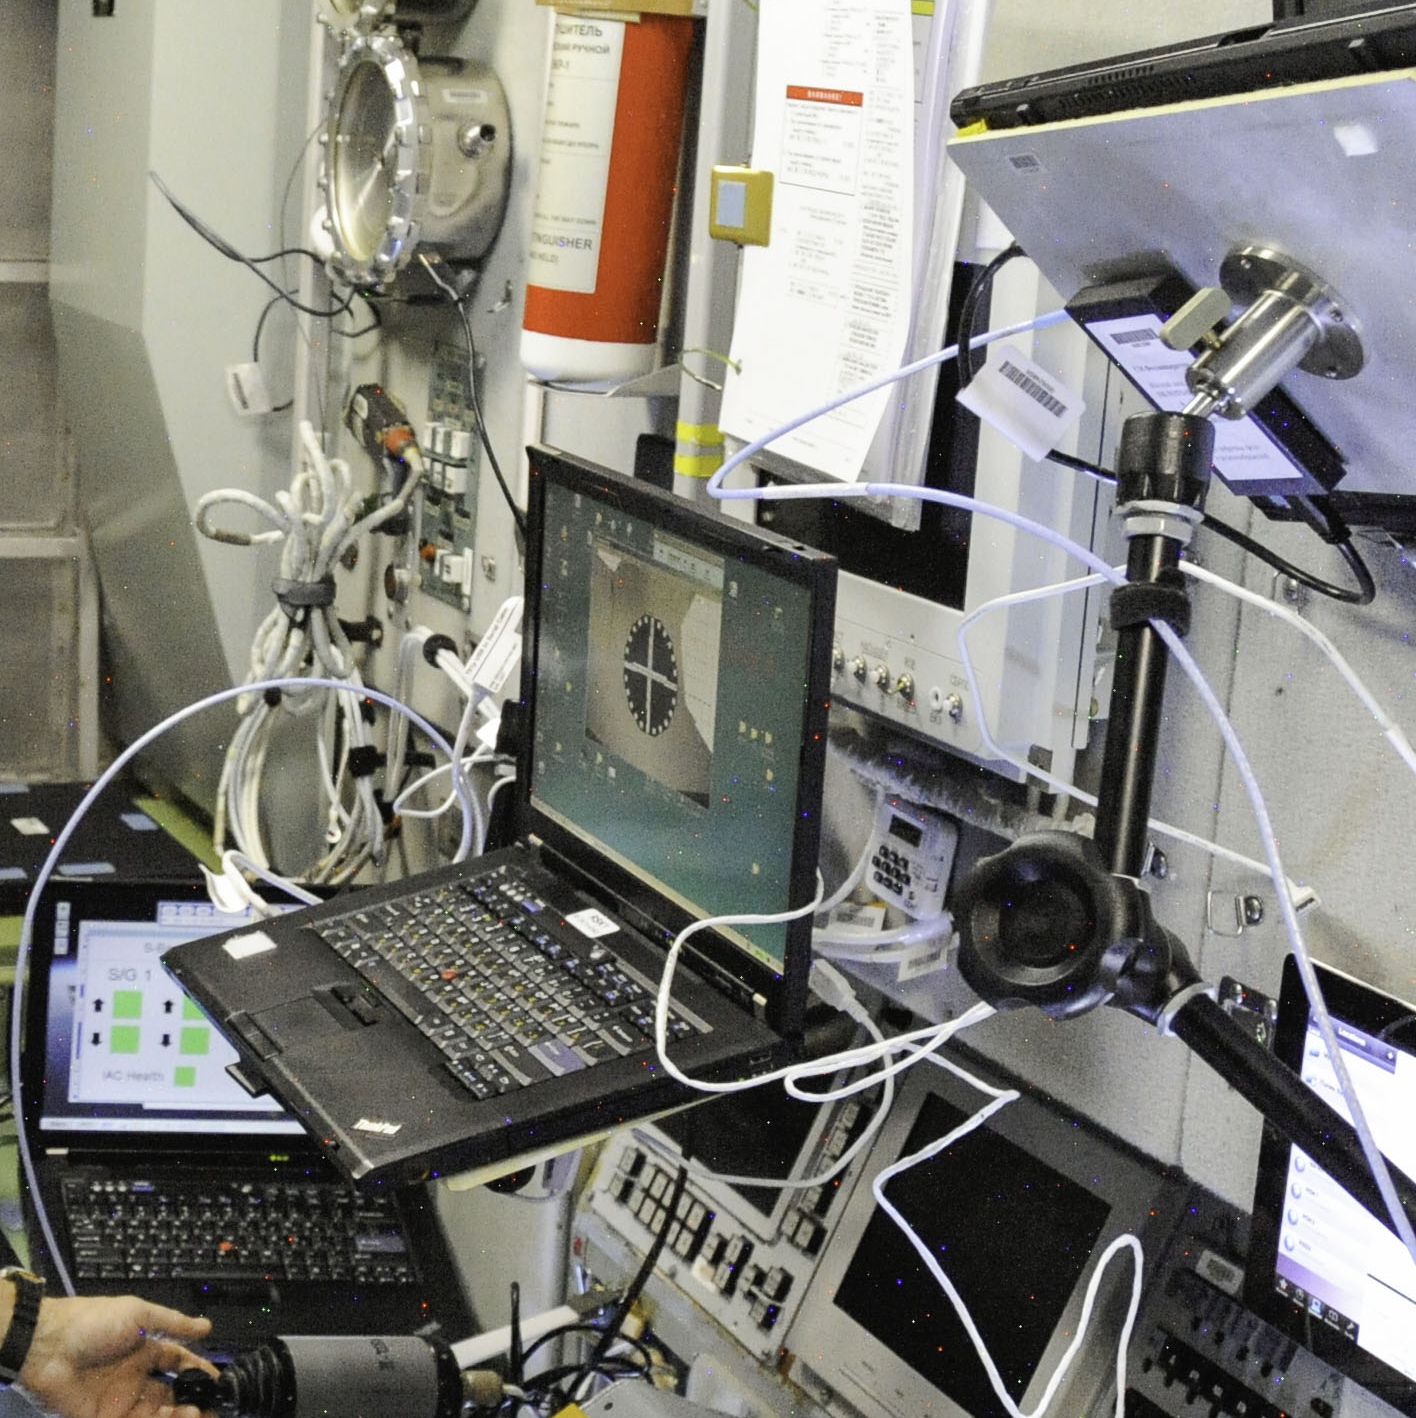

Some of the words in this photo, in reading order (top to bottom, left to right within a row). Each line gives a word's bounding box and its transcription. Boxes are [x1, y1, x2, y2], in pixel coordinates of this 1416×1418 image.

[109, 968, 137, 982] S/G
[146, 969, 152, 980] 1
[126, 1071, 165, 1082] Health
